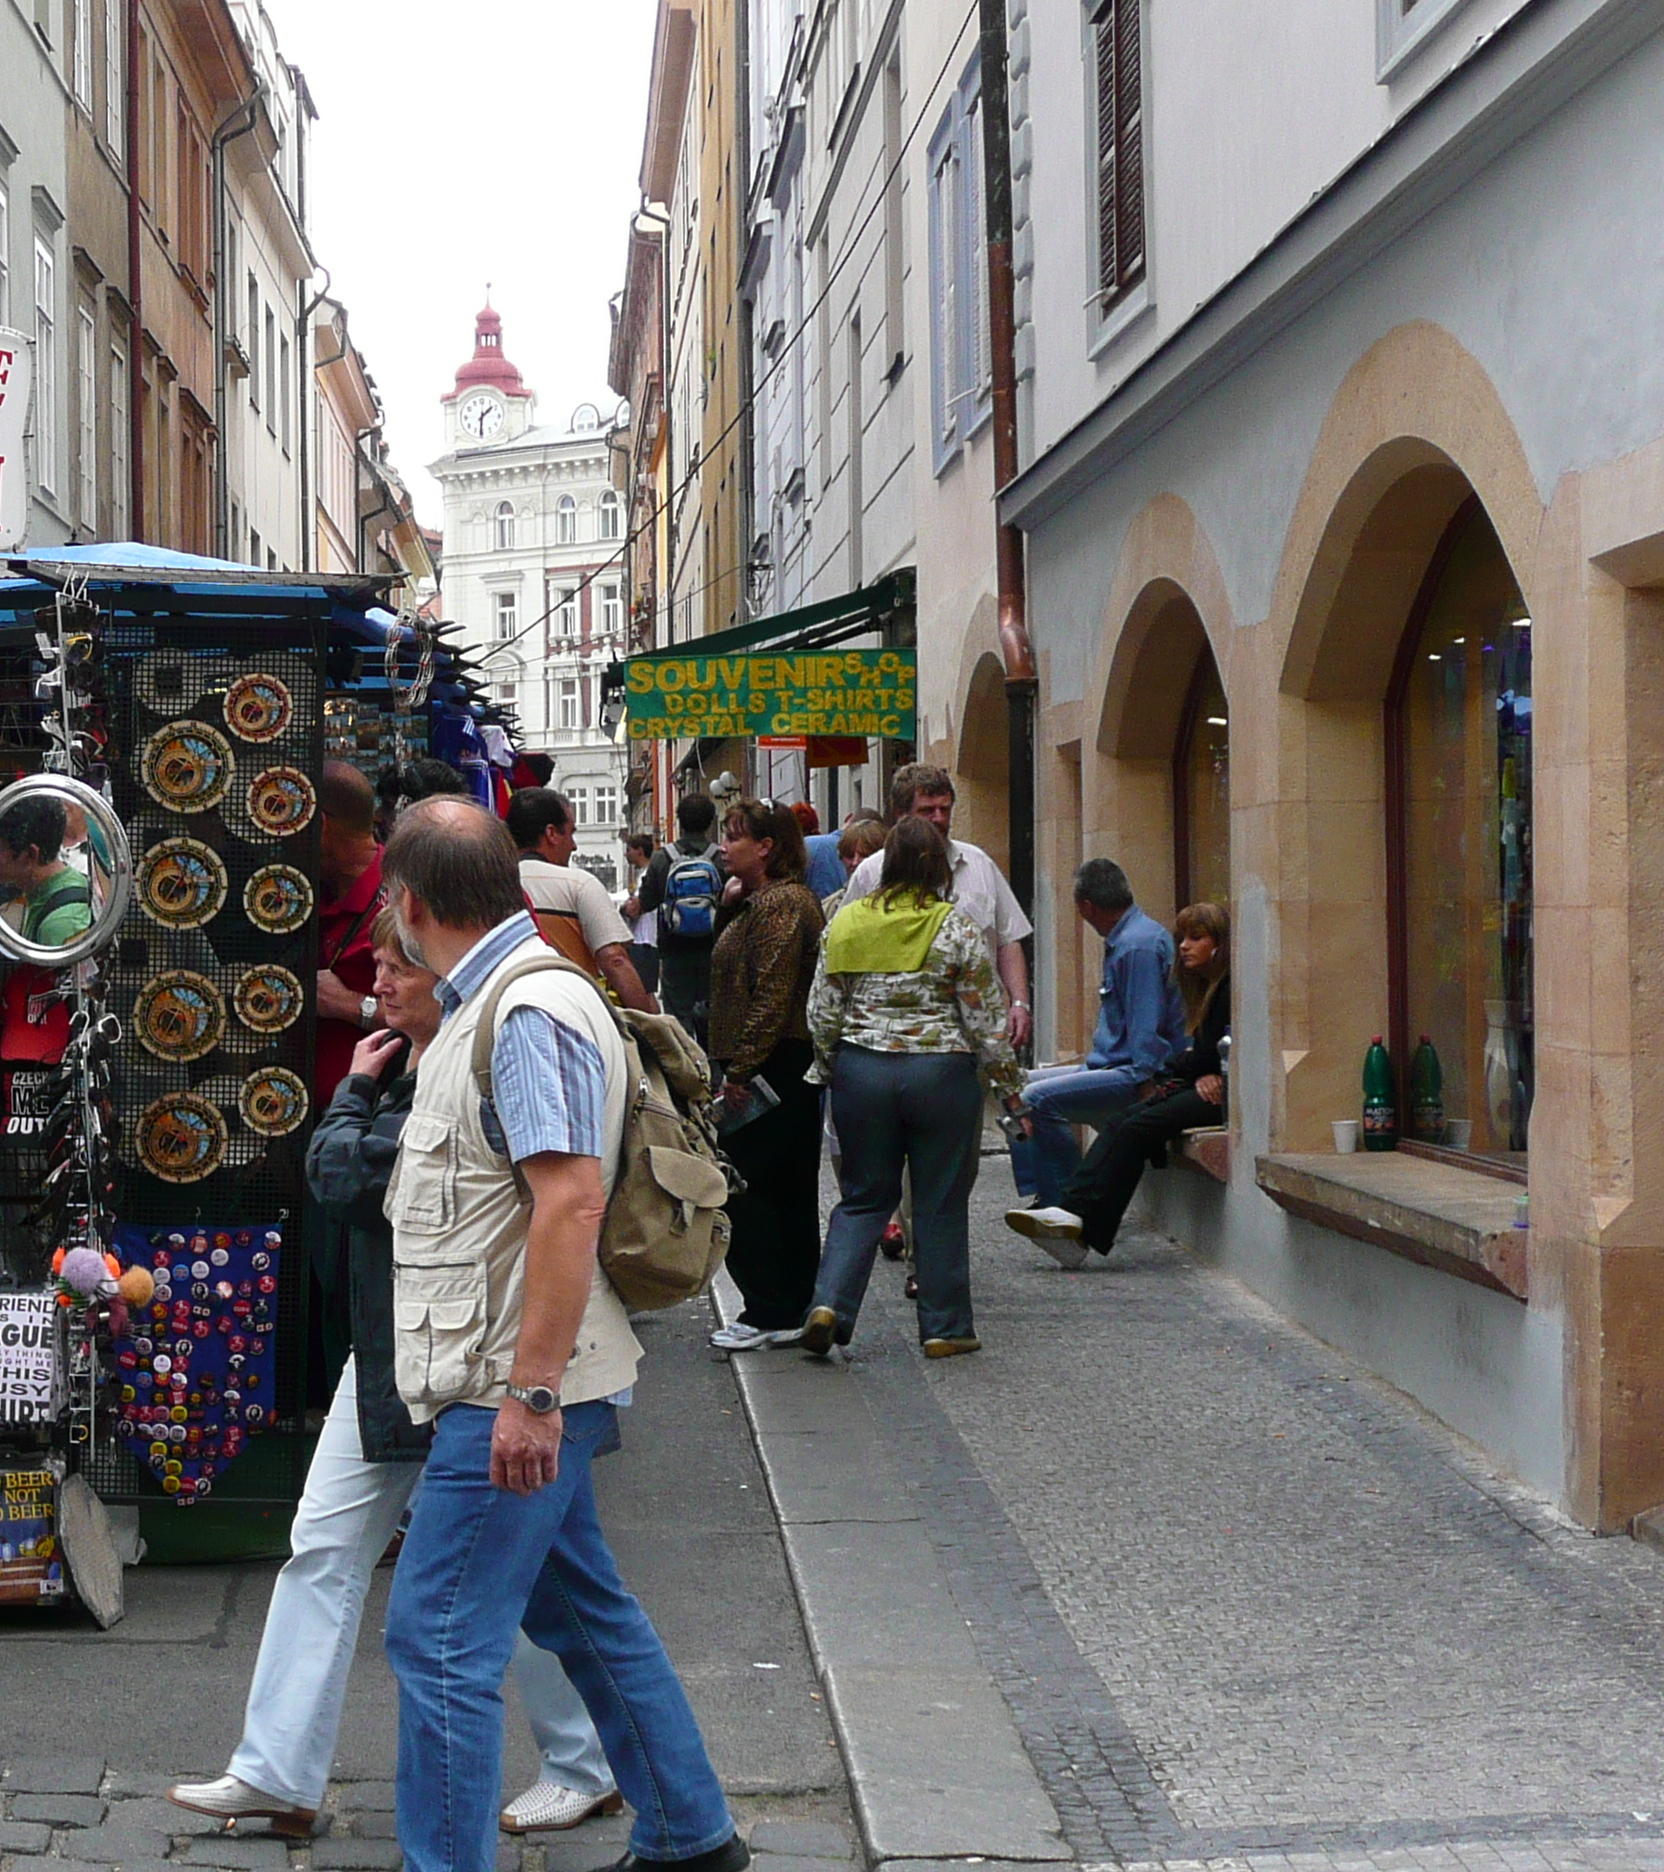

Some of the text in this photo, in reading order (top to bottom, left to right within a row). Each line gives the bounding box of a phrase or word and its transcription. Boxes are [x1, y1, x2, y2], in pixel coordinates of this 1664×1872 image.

[627, 656, 845, 694] SOUVENIR
[665, 688, 914, 715] DOLLS T-SHIRTS
[627, 713, 901, 739] CRYSTAL CERAMIC
[29, 1315, 54, 1326] IN
[16, 1349, 52, 1360] THING
[35, 1359, 52, 1369] ME
[5, 1472, 53, 1488] BEER
[4, 1488, 41, 1504] NOT
[9, 1504, 54, 1521] BEER
